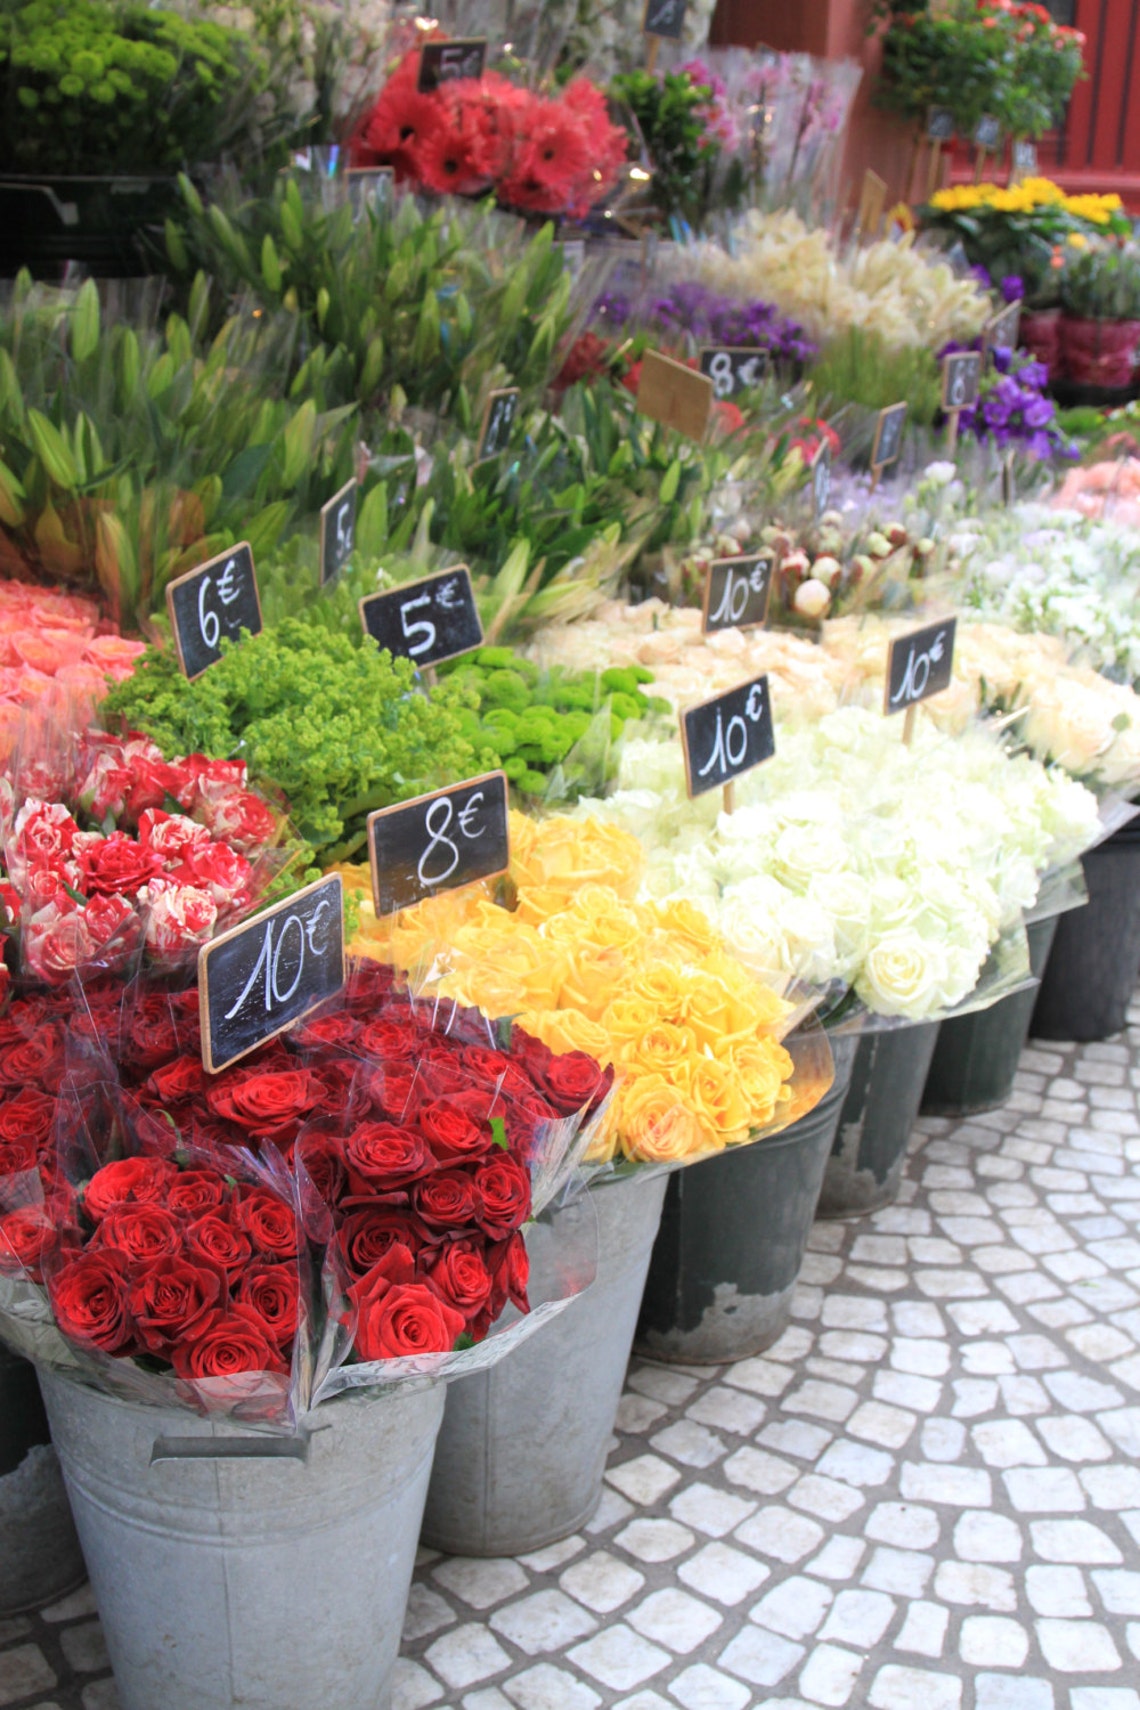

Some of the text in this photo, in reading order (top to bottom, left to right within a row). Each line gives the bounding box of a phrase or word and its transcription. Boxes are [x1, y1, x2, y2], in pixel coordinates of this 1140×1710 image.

[198, 559, 243, 649] 6€
[400, 578, 464, 657] 5€
[709, 561, 767, 623] 10€
[891, 631, 946, 704] 10€
[698, 684, 763, 776] 10€
[417, 792, 487, 885] 8€
[224, 900, 330, 1019] 10€
